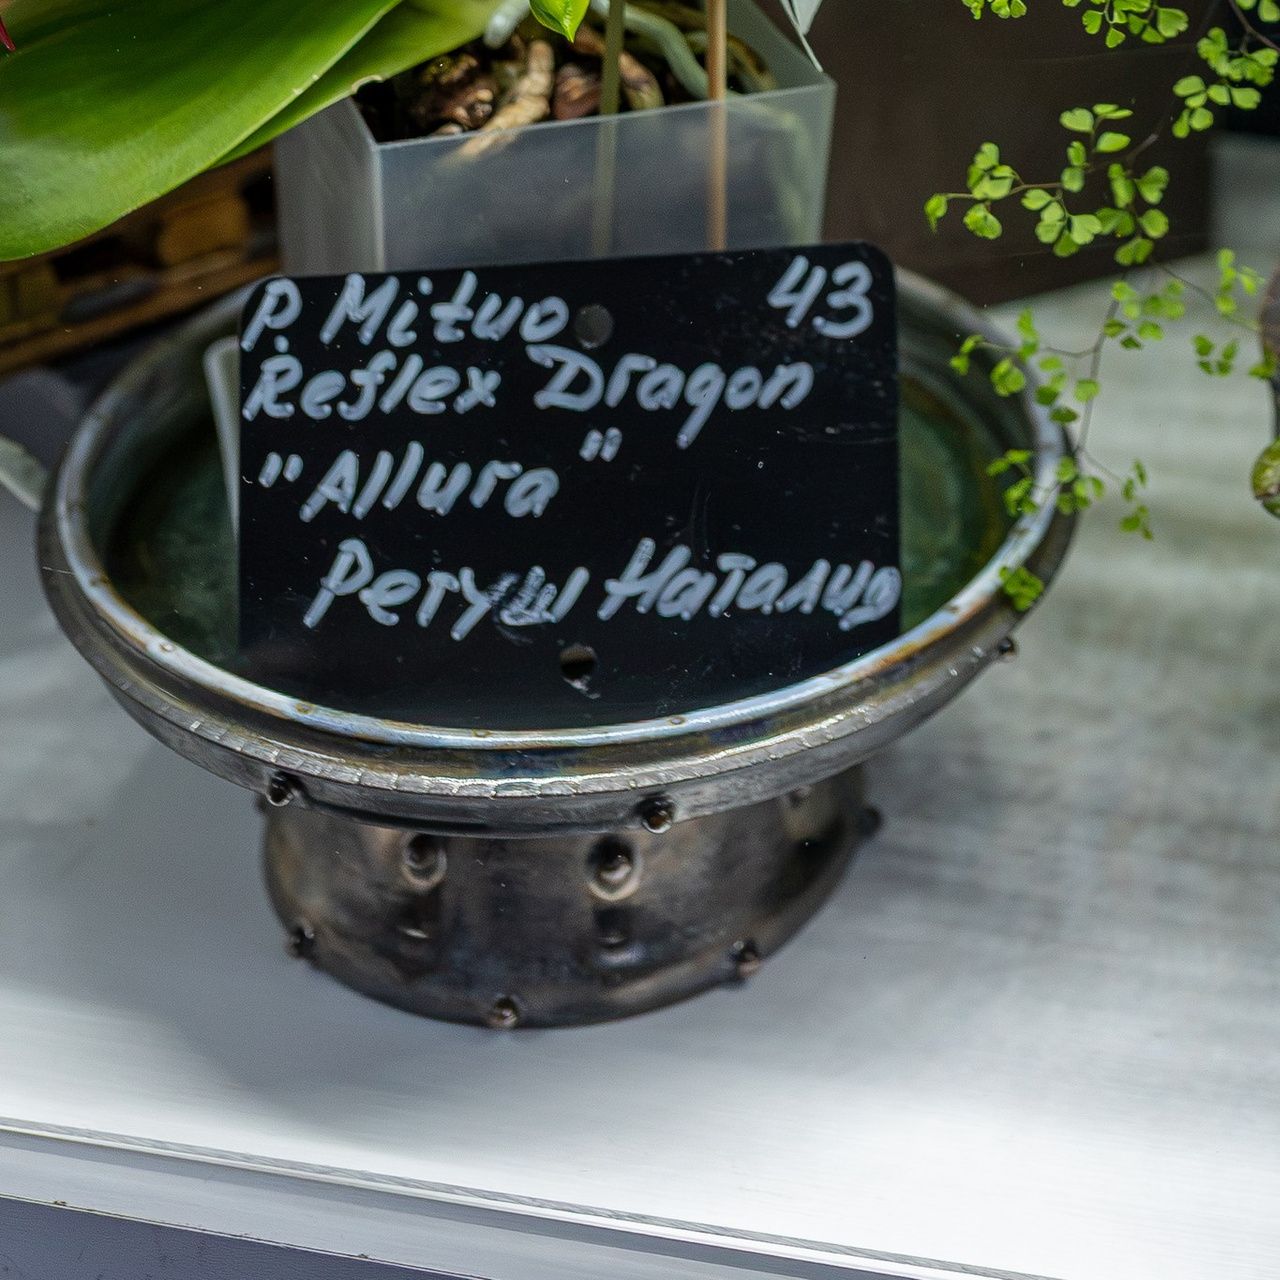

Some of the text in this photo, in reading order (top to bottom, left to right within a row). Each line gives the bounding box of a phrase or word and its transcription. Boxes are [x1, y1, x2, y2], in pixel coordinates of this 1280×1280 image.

[321, 270, 569, 346] Mituo
[768, 256, 872, 339] 43
[242, 343, 813, 449] Reflex Dragon
[597, 536, 902, 631] Наталия
